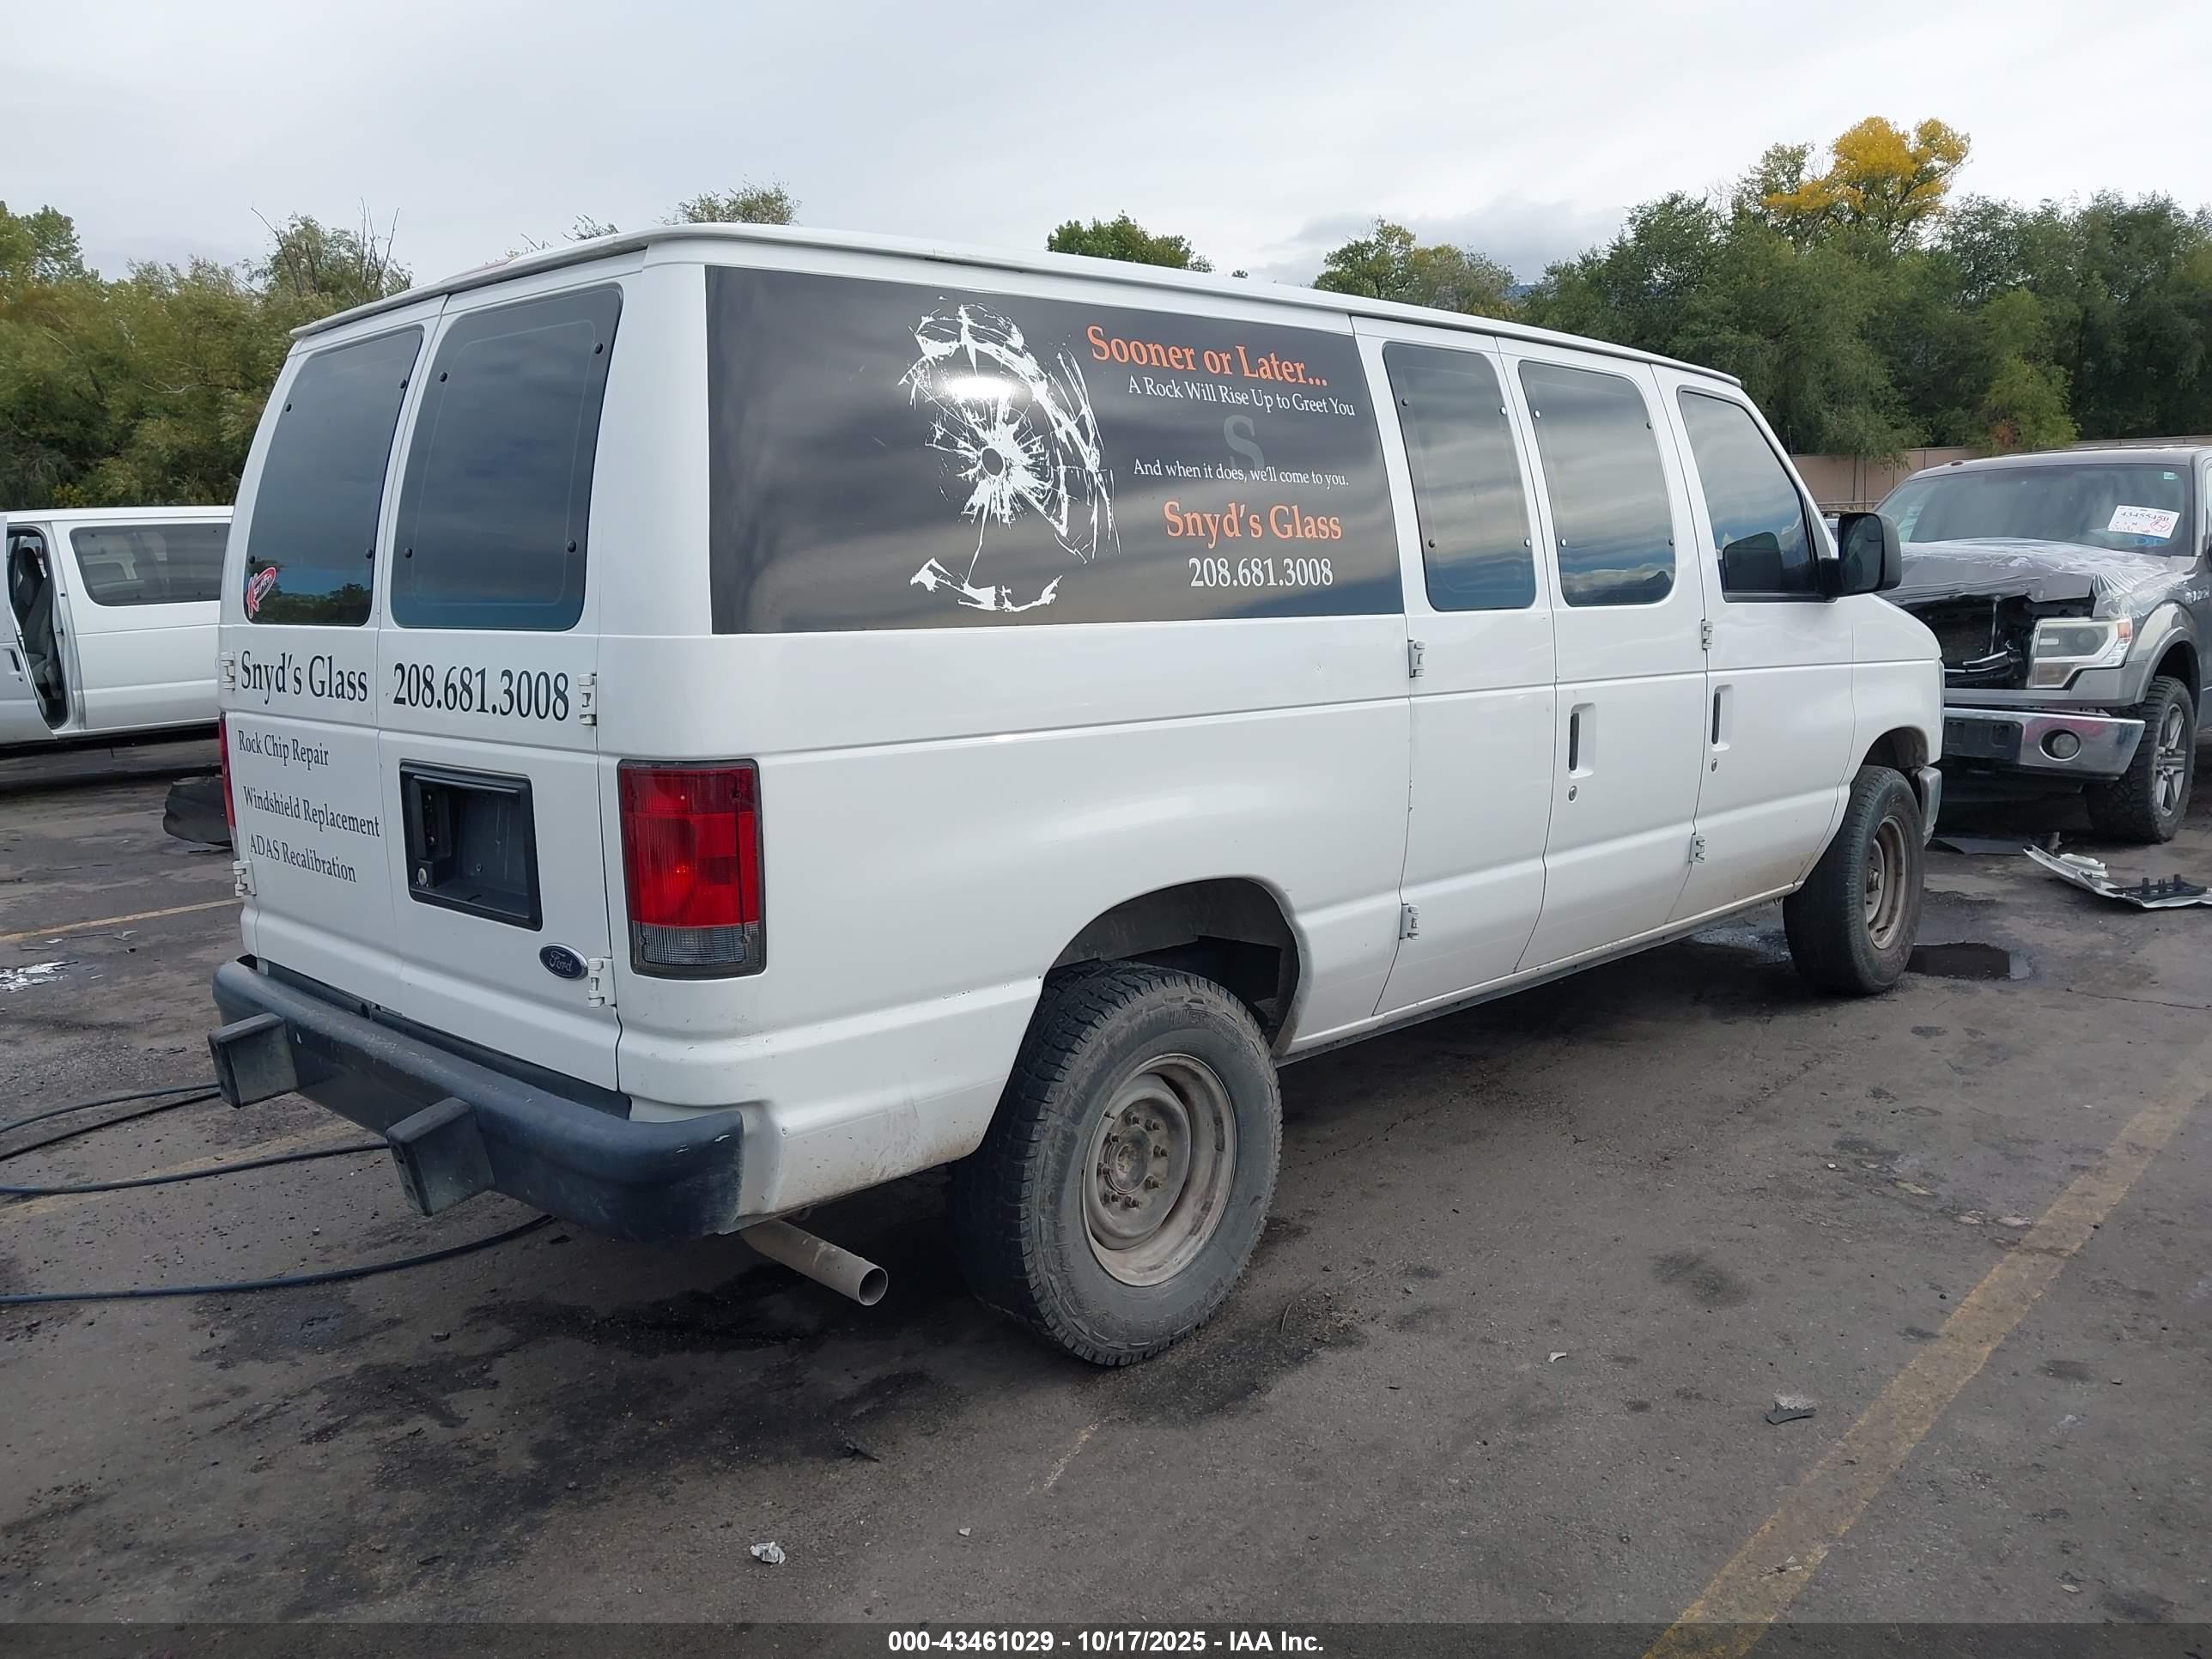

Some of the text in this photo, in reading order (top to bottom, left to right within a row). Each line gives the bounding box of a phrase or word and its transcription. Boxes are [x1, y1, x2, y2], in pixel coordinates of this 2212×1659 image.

[1087, 325, 1328, 386] Sooner or Later...
[1128, 375, 1355, 416] A Rock Will Rise Up to Greet You
[1133, 459, 1349, 489] And when it does, we'll come to you.
[1164, 501, 1343, 549] Snyd's Glass
[1188, 557, 1334, 587] 208.681.3008
[240, 650, 368, 705] Snyd's Glass
[392, 662, 569, 720] 208.681.3008
[238, 730, 329, 769] Rock Chip Repair
[243, 786, 380, 838] Windshield Replacement
[249, 832, 356, 883] ADAS Recalibration
[550, 951, 573, 972] Ford
